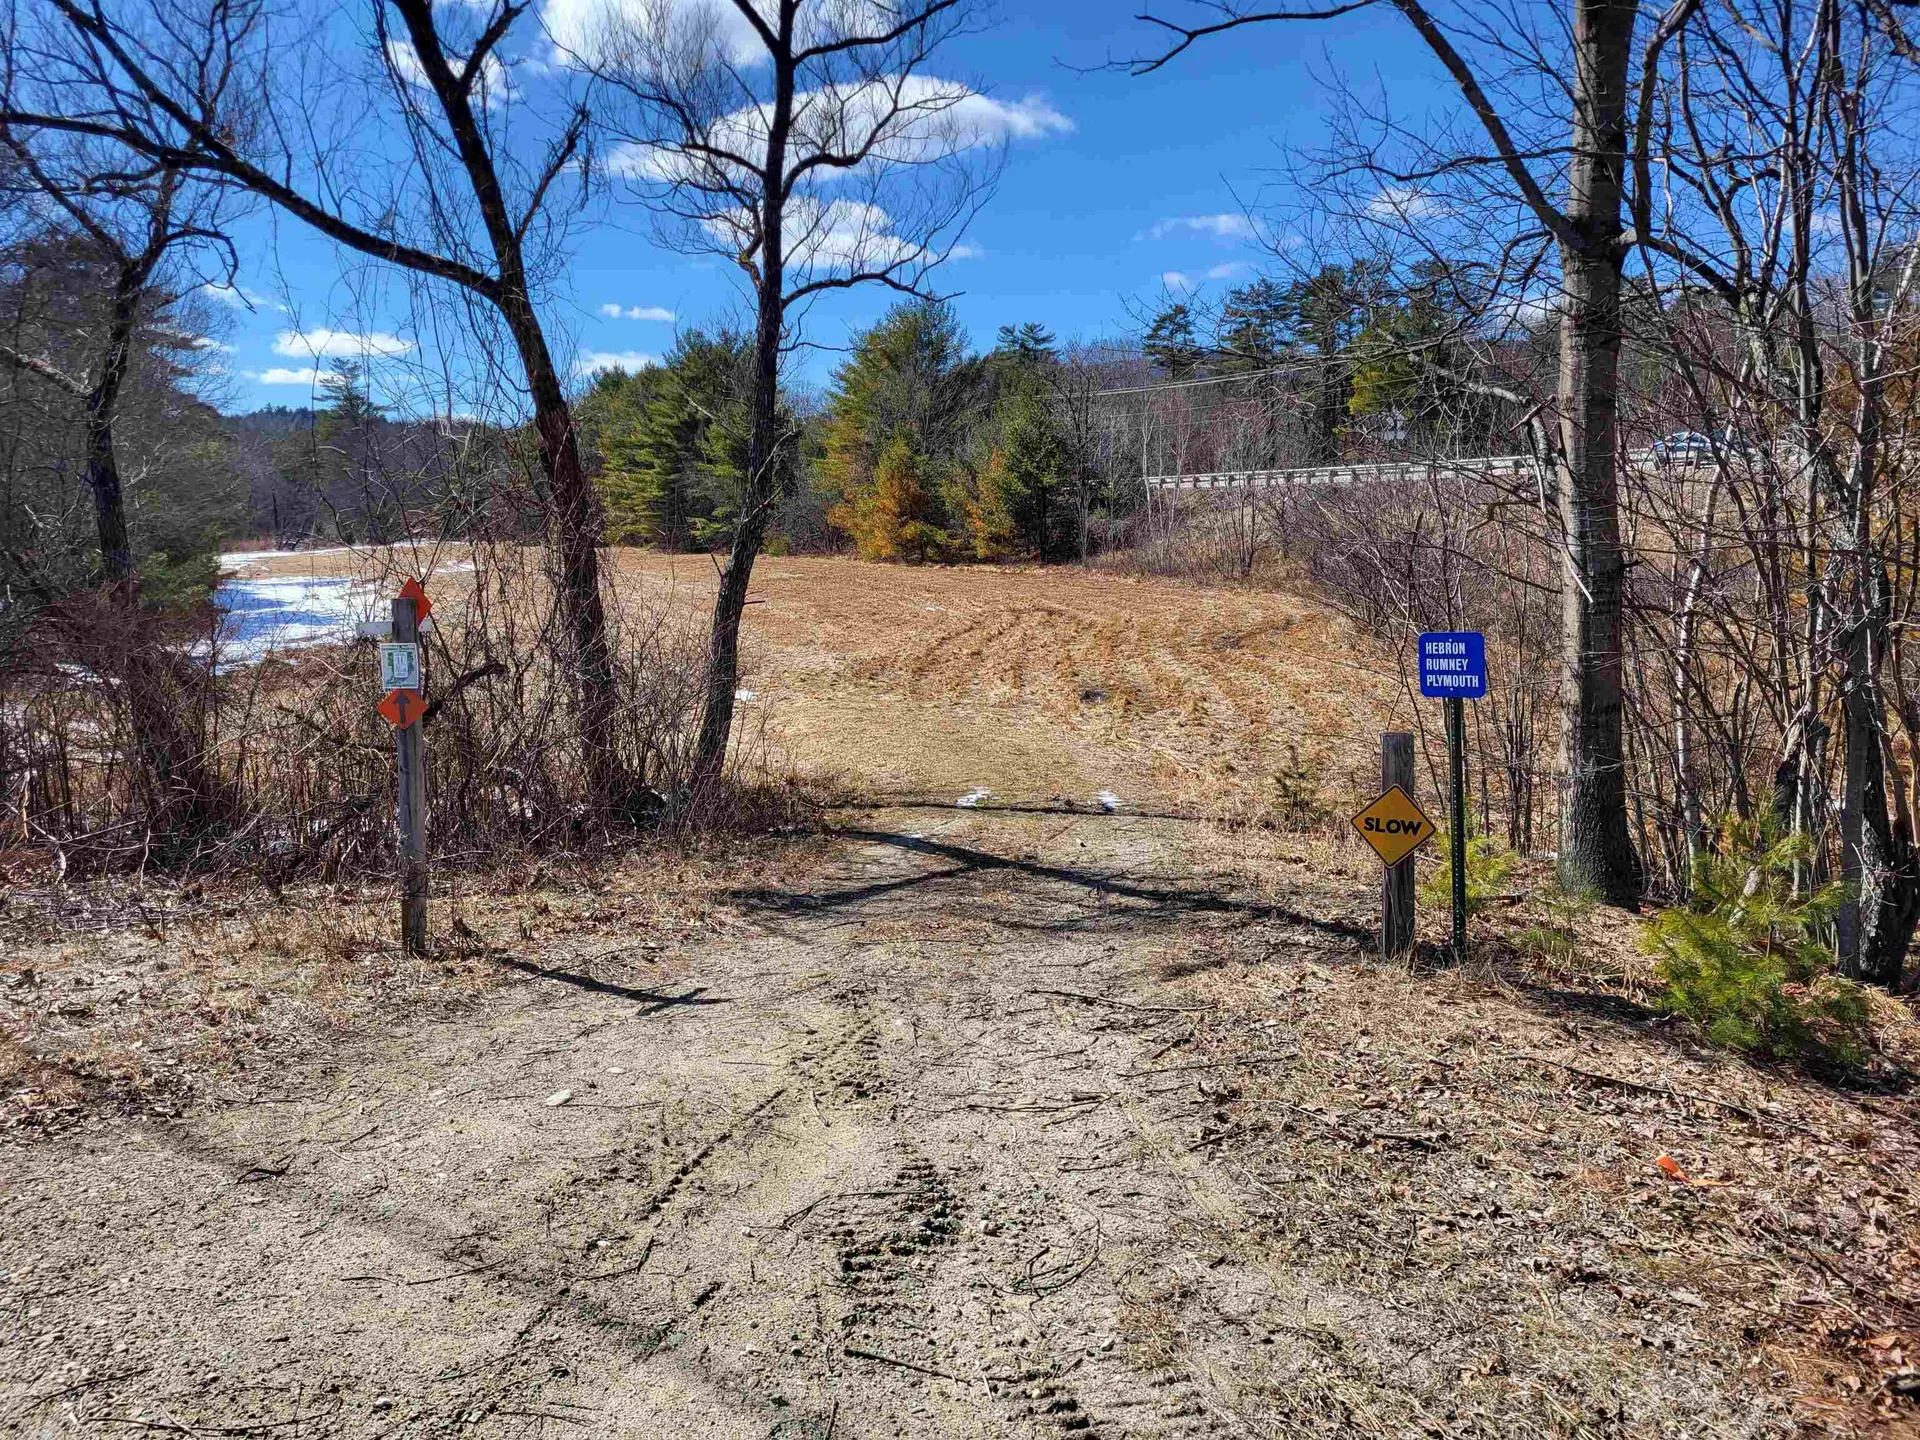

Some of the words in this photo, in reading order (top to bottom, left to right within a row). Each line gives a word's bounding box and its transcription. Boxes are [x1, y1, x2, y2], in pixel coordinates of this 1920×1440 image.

[1425, 642, 1466, 655] HEBRON
[1426, 658, 1469, 671] RUMNEY
[1426, 674, 1479, 688] PLYMOUTH
[1363, 816, 1423, 836] SLOW
